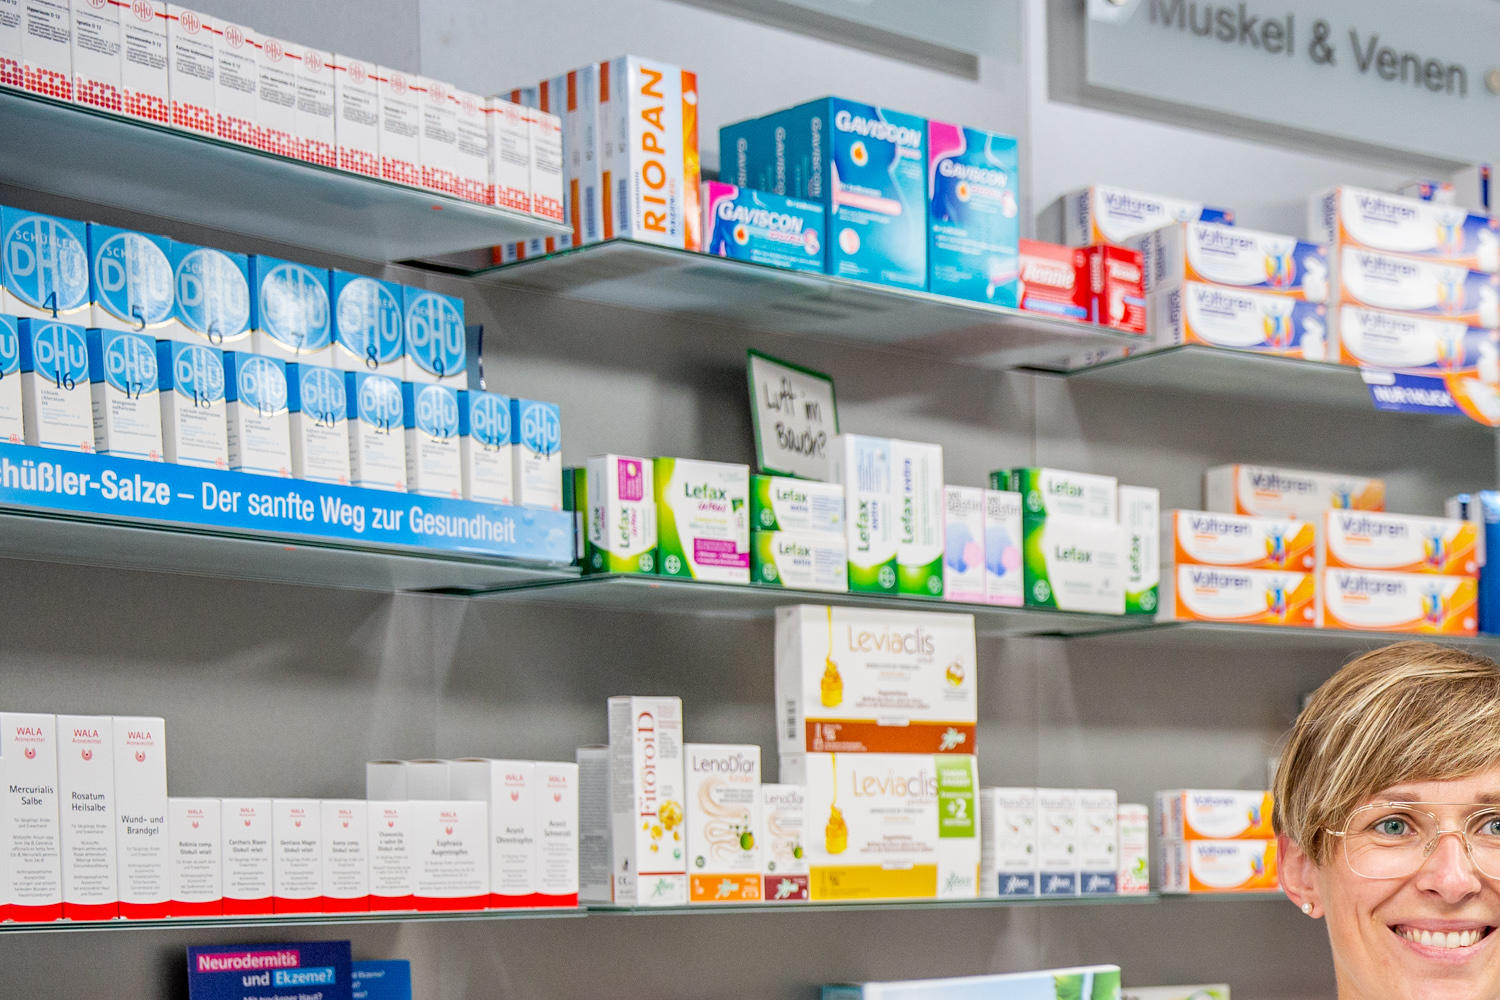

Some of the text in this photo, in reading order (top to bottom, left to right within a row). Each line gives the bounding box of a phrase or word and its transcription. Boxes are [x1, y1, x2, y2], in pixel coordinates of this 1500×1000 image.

[1148, 0, 1468, 97] Muskel & Venen
[835, 110, 922, 149] GAVISCON
[640, 65, 668, 233] RIOPAN
[939, 158, 1009, 187] GAVISCON
[717, 201, 804, 234] GAVISCON
[42, 291, 60, 319] 4
[132, 305, 146, 332] 5
[207, 320, 223, 346] 6
[365, 343, 378, 371] 8
[432, 357, 444, 380] 9
[55, 370, 75, 391] 16
[126, 381, 143, 400] 17
[192, 390, 212, 410] 18
[314, 410, 335, 430] 20
[684, 482, 727, 502] Lefax
[1048, 479, 1084, 498] Lefax
[1251, 472, 1317, 494] Voltaren
[776, 487, 808, 503] Lefax
[202, 482, 241, 512] Der
[248, 488, 314, 522] sanfte
[320, 496, 365, 533] Weg
[372, 507, 404, 531] zur
[409, 505, 516, 543] Gesundheit
[901, 496, 914, 545] Lefax
[617, 507, 631, 548] Lefax
[858, 501, 870, 552] Lefax
[1190, 517, 1251, 536] Voltaren
[1342, 518, 1408, 538] Voltaren
[778, 542, 811, 557] Lefax
[1055, 546, 1093, 564] Lefax
[1128, 535, 1141, 583] Lefax
[1190, 572, 1252, 589] Voltaren
[1339, 573, 1406, 595] Voltaren
[848, 625, 935, 657] Leviaclis
[16, 727, 43, 737] WALA
[73, 729, 99, 739] WALA
[127, 731, 152, 740] WALA
[9, 784, 54, 795] Mercurialis
[852, 769, 939, 799] Leviaclis
[21, 796, 44, 806] Salbe
[71, 791, 106, 802] Rosatum
[71, 802, 107, 813] Heilsalbe
[121, 815, 165, 825] Wund- und
[127, 826, 160, 837] Brandgel
[199, 951, 298, 970] Neurodermitis
[242, 968, 333, 987] und Ekzeme?
